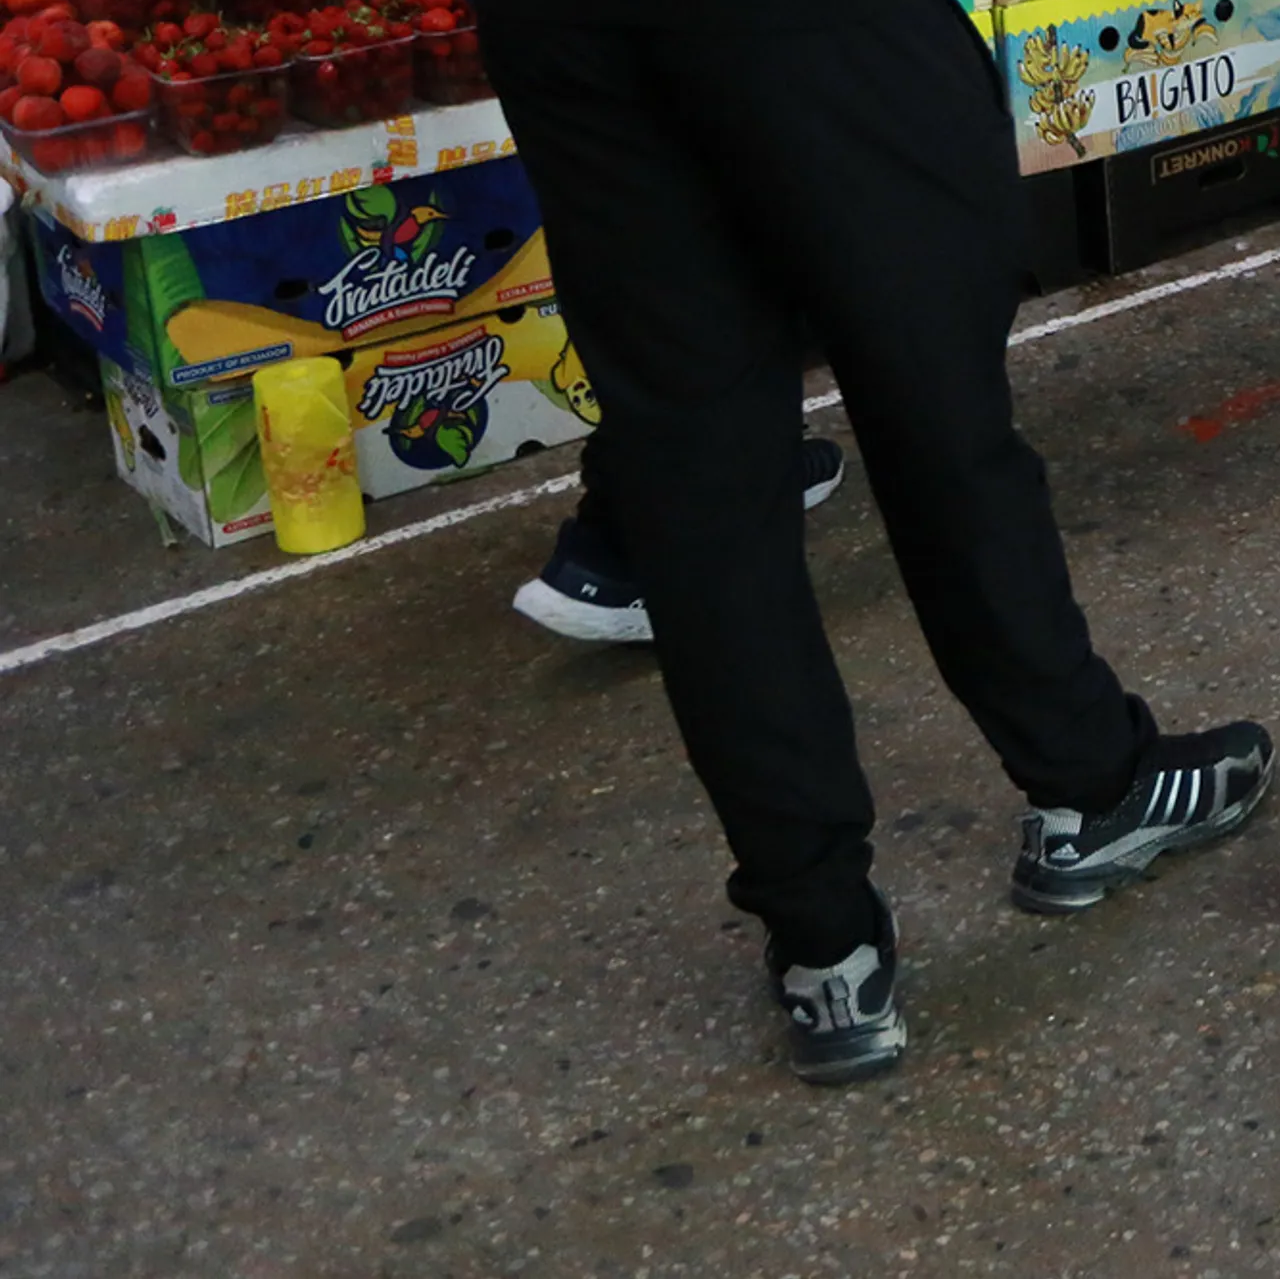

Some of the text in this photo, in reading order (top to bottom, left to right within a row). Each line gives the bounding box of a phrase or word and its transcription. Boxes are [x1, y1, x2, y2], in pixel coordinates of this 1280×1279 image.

[1159, 138, 1253, 179] KONKRET
[317, 246, 476, 326] Frutadeli
[359, 336, 510, 418] Frutadeli
